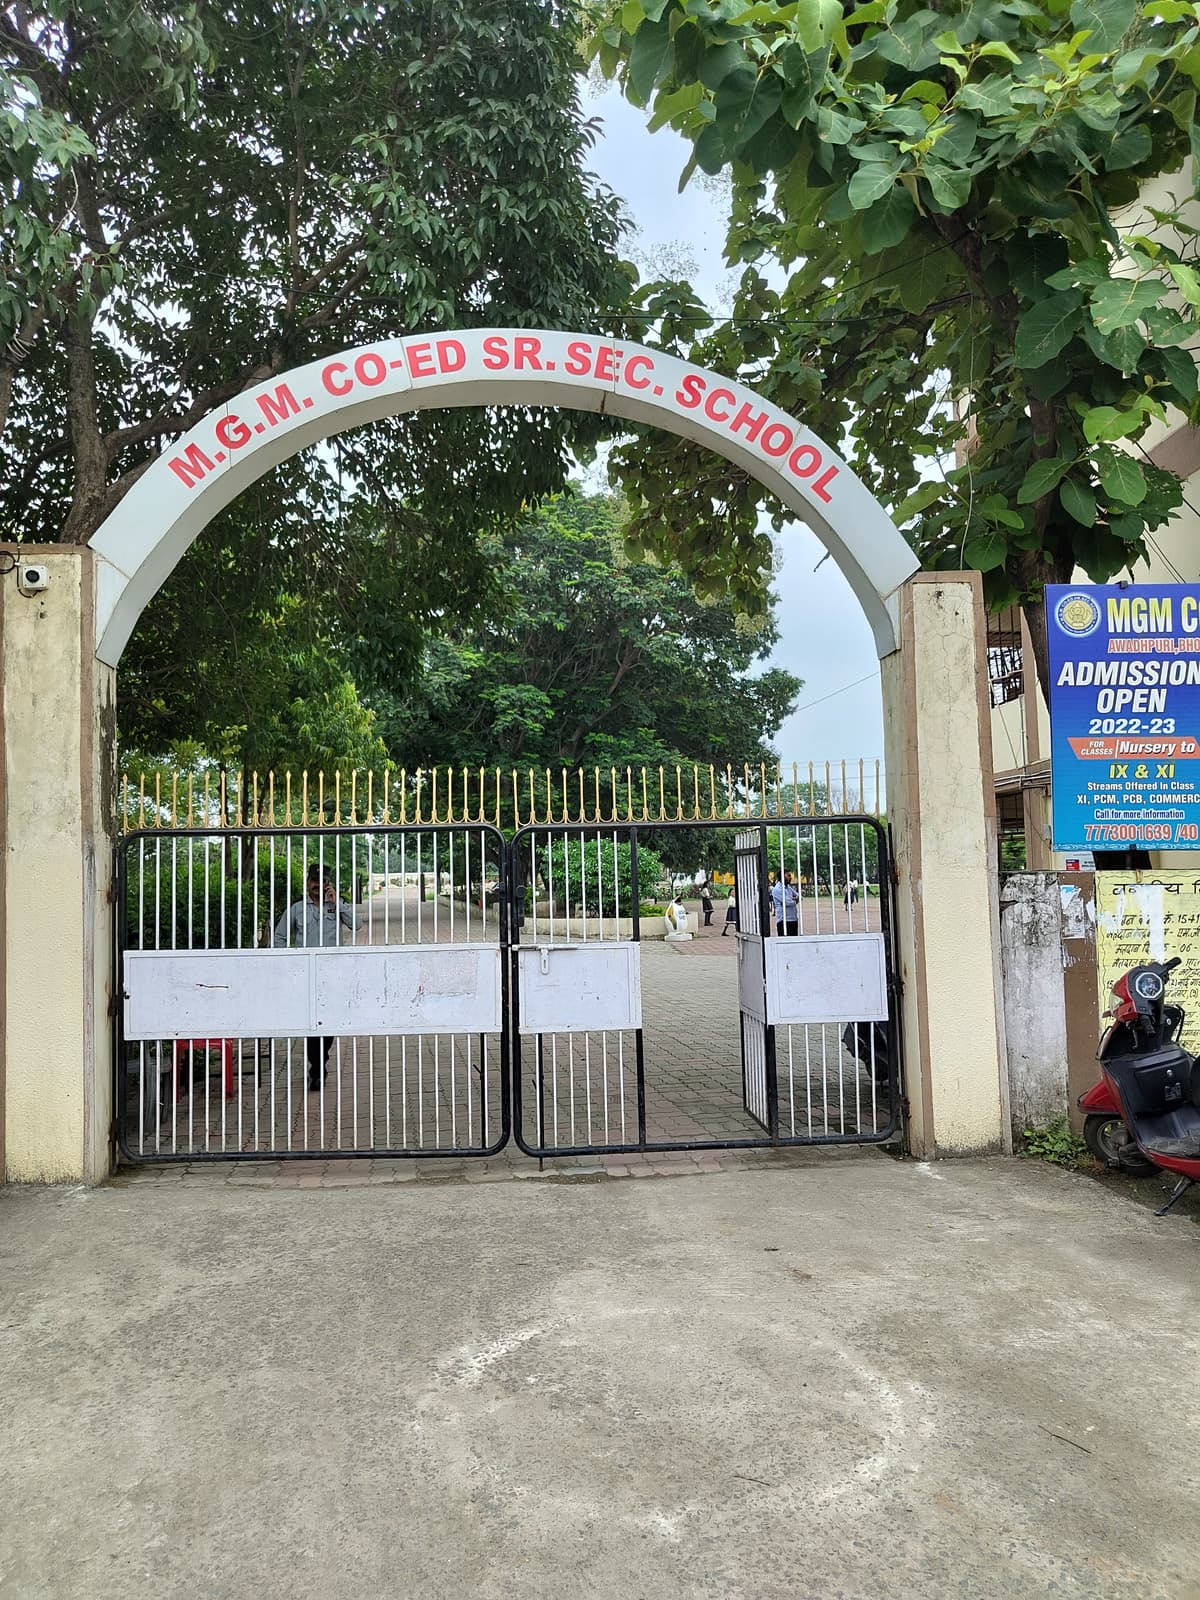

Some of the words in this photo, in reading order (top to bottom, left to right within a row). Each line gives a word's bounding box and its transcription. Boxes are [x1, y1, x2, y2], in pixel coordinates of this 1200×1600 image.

[168, 383, 313, 489] M.G.M.
[321, 339, 467, 397] CO-ED
[675, 374, 839, 503] SCHOOL
[1107, 597, 1172, 633] MGM
[1181, 596, 1200, 633] C
[1057, 660, 1200, 686] ADMISSION
[1097, 688, 1167, 713] OPEN
[1088, 718, 1176, 735] 2022-23
[1080, 748, 1114, 756] CLASSES
[1119, 740, 1177, 757] Nursery
[1181, 740, 1196, 754] to
[1109, 764, 1129, 779] IX
[1134, 764, 1149, 779] &
[1155, 764, 1175, 779] XI
[1087, 781, 1123, 791] Streams
[1125, 781, 1158, 790] Offered
[1170, 781, 1195, 790] Class
[1077, 794, 1091, 805] XI,
[1093, 794, 1120, 805] PCM,
[1123, 794, 1147, 805] PCB,
[1095, 809, 1111, 820] Call
[1111, 809, 1122, 820] for
[1123, 810, 1142, 820] more
[1084, 824, 1171, 841] 7773001639
